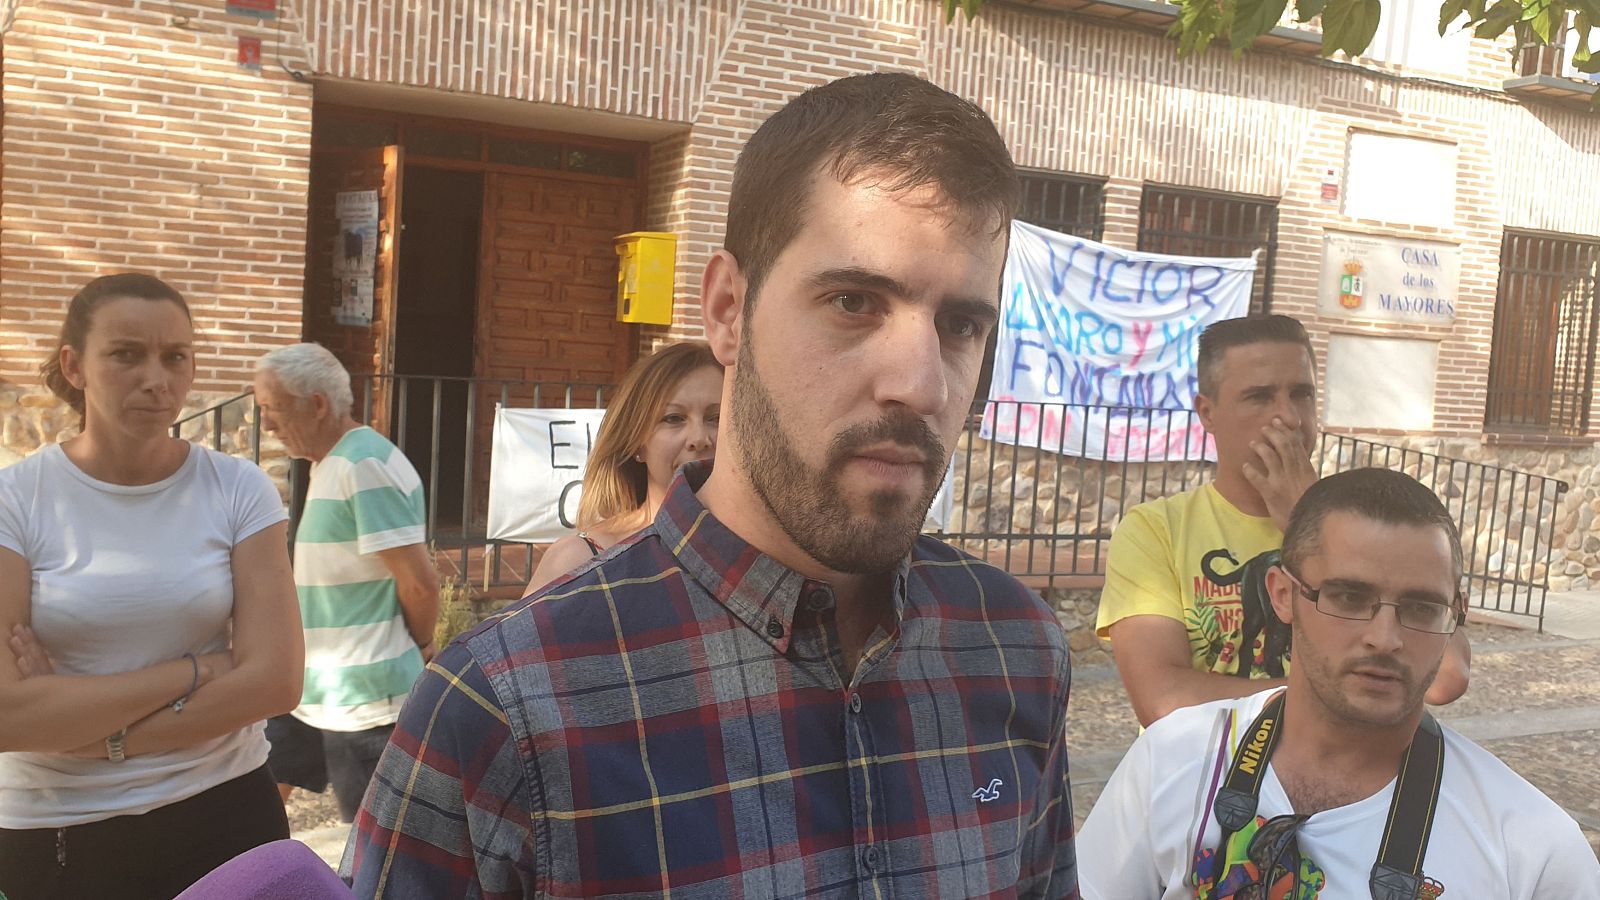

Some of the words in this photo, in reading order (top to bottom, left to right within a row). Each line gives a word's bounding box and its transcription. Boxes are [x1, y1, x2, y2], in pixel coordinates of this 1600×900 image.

[1401, 247, 1439, 267] CASA
[1402, 272, 1415, 287] de
[1419, 273, 1435, 288] los
[1378, 293, 1454, 316] MAYORES
[1239, 718, 1274, 775] Nikon
